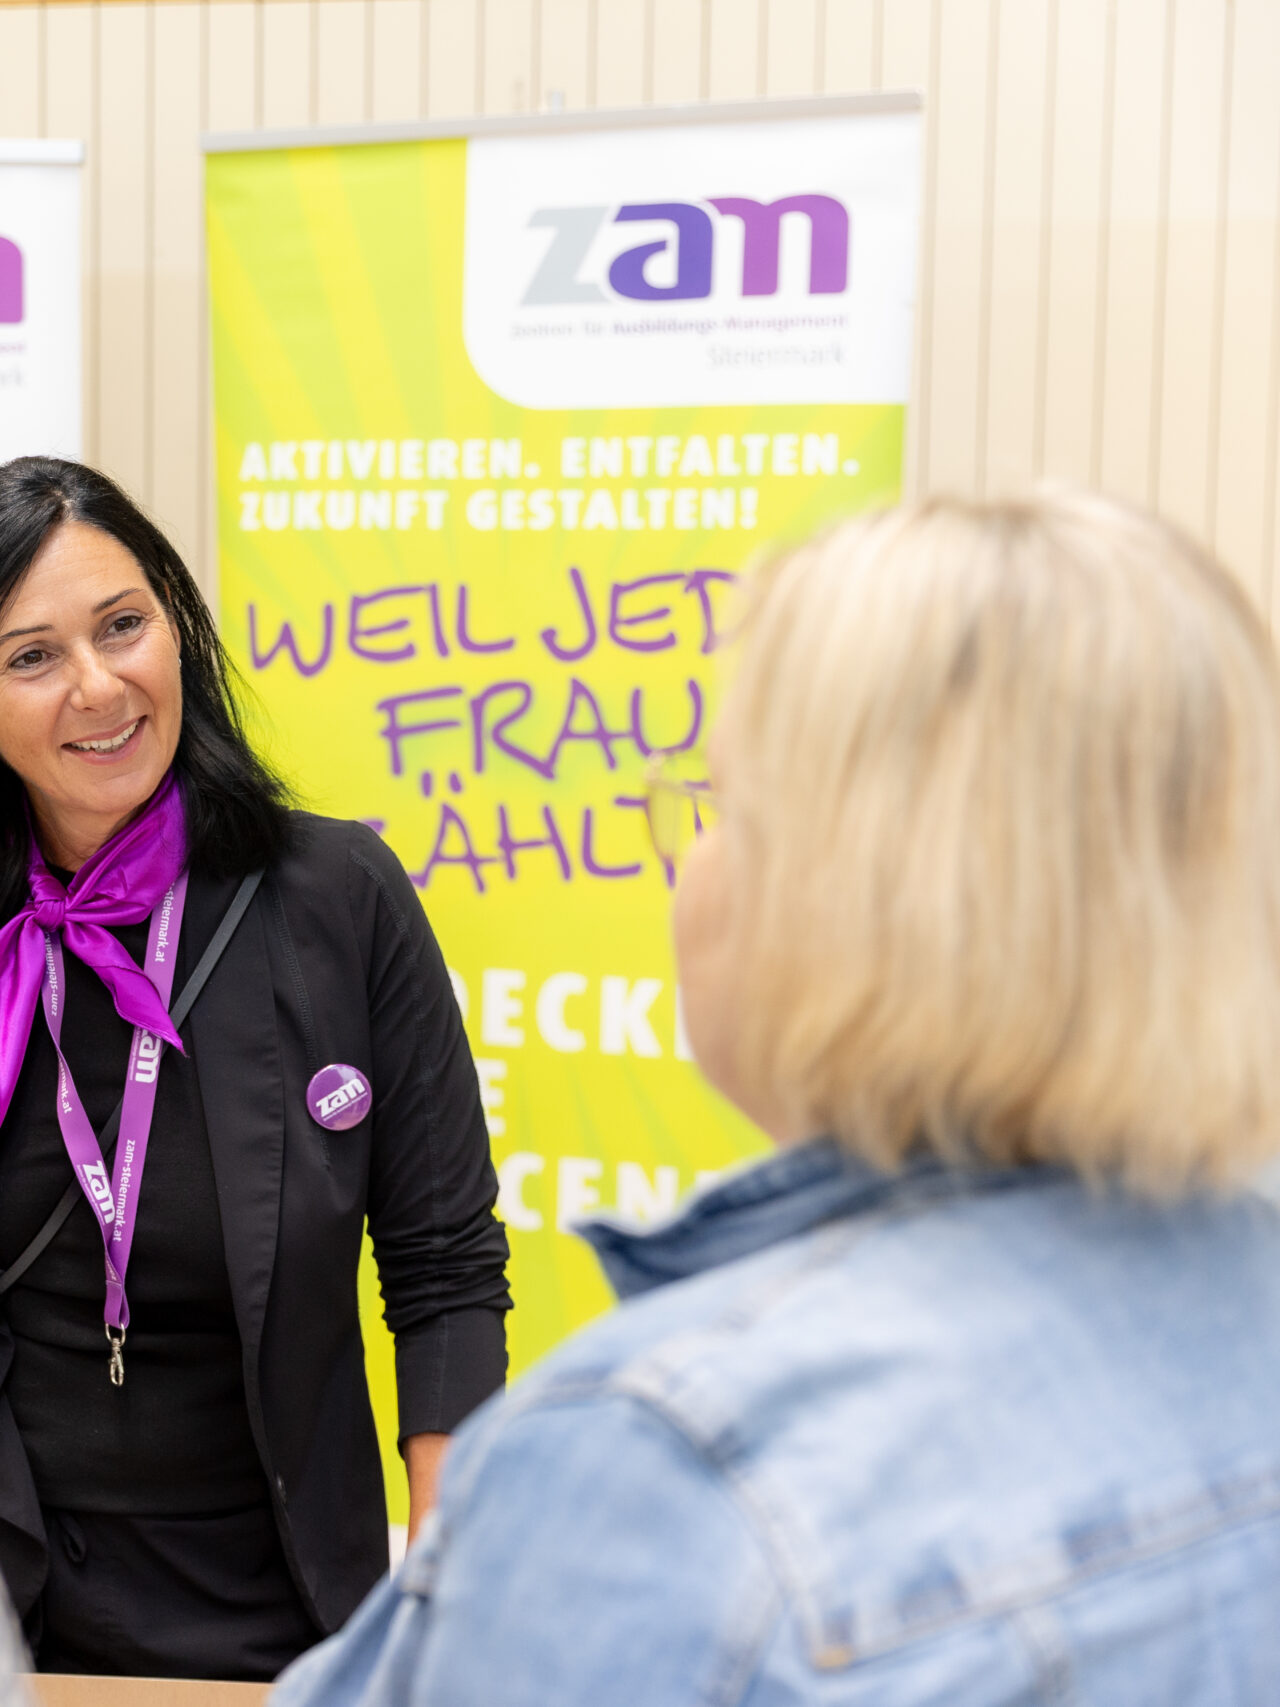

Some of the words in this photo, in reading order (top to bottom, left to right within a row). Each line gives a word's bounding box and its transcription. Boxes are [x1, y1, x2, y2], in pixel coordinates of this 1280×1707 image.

[520, 194, 851, 306] zam
[238, 439, 542, 481] AKTIVIEREN.
[560, 434, 860, 478] ENTFALTEN.
[238, 490, 450, 531] ZUKUNFT
[465, 487, 758, 531] GESTALTEN!
[248, 583, 515, 678] WEIL
[376, 678, 703, 780] FRAU
[360, 771, 711, 894] ÄHLT
[135, 1029, 161, 1083] am
[447, 967, 696, 1061] ECK
[315, 1078, 366, 1118] zam
[83, 1160, 116, 1224] zam
[113, 1139, 136, 1241] zam-steiermark.at
